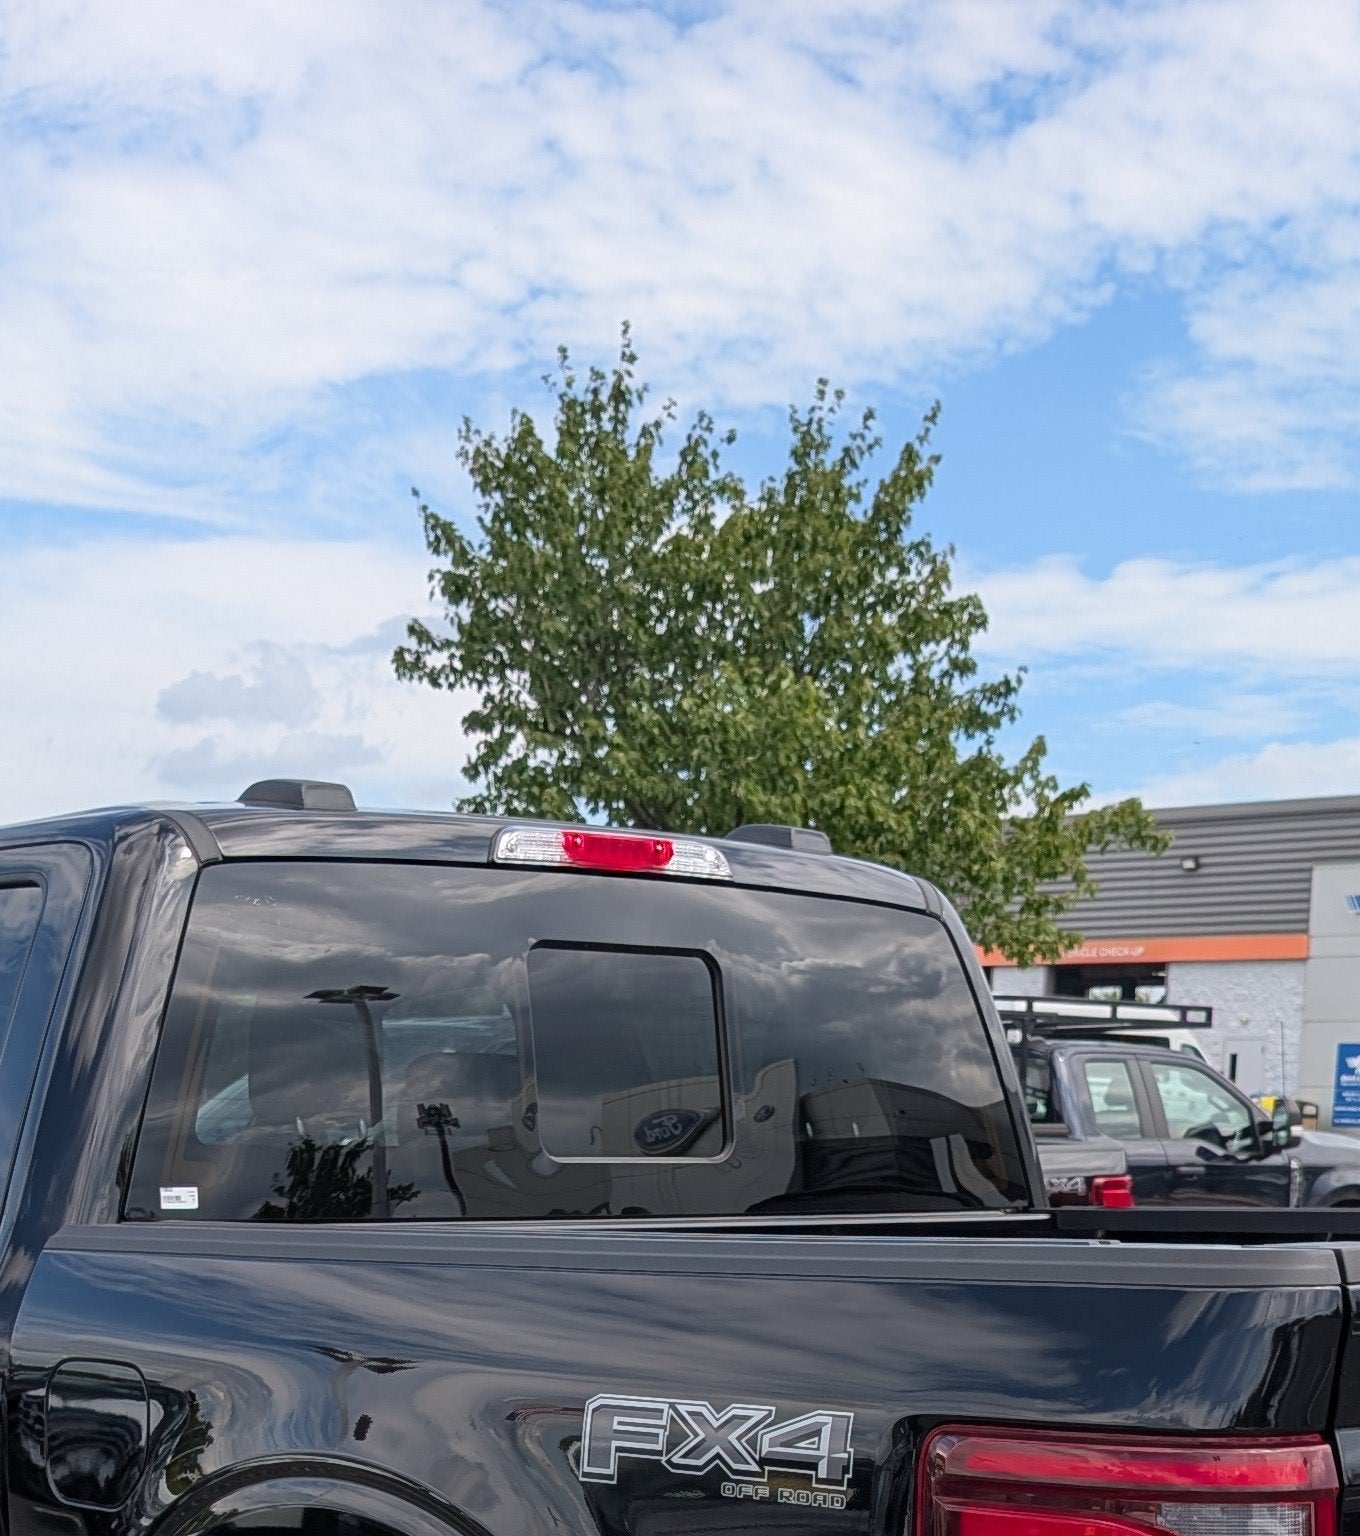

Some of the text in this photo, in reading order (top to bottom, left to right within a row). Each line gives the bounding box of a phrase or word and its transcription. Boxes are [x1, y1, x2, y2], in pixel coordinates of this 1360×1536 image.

[1047, 1176, 1087, 1196] X4
[579, 1393, 854, 1491] FX4
[720, 1482, 846, 1509] OFF ROAD
